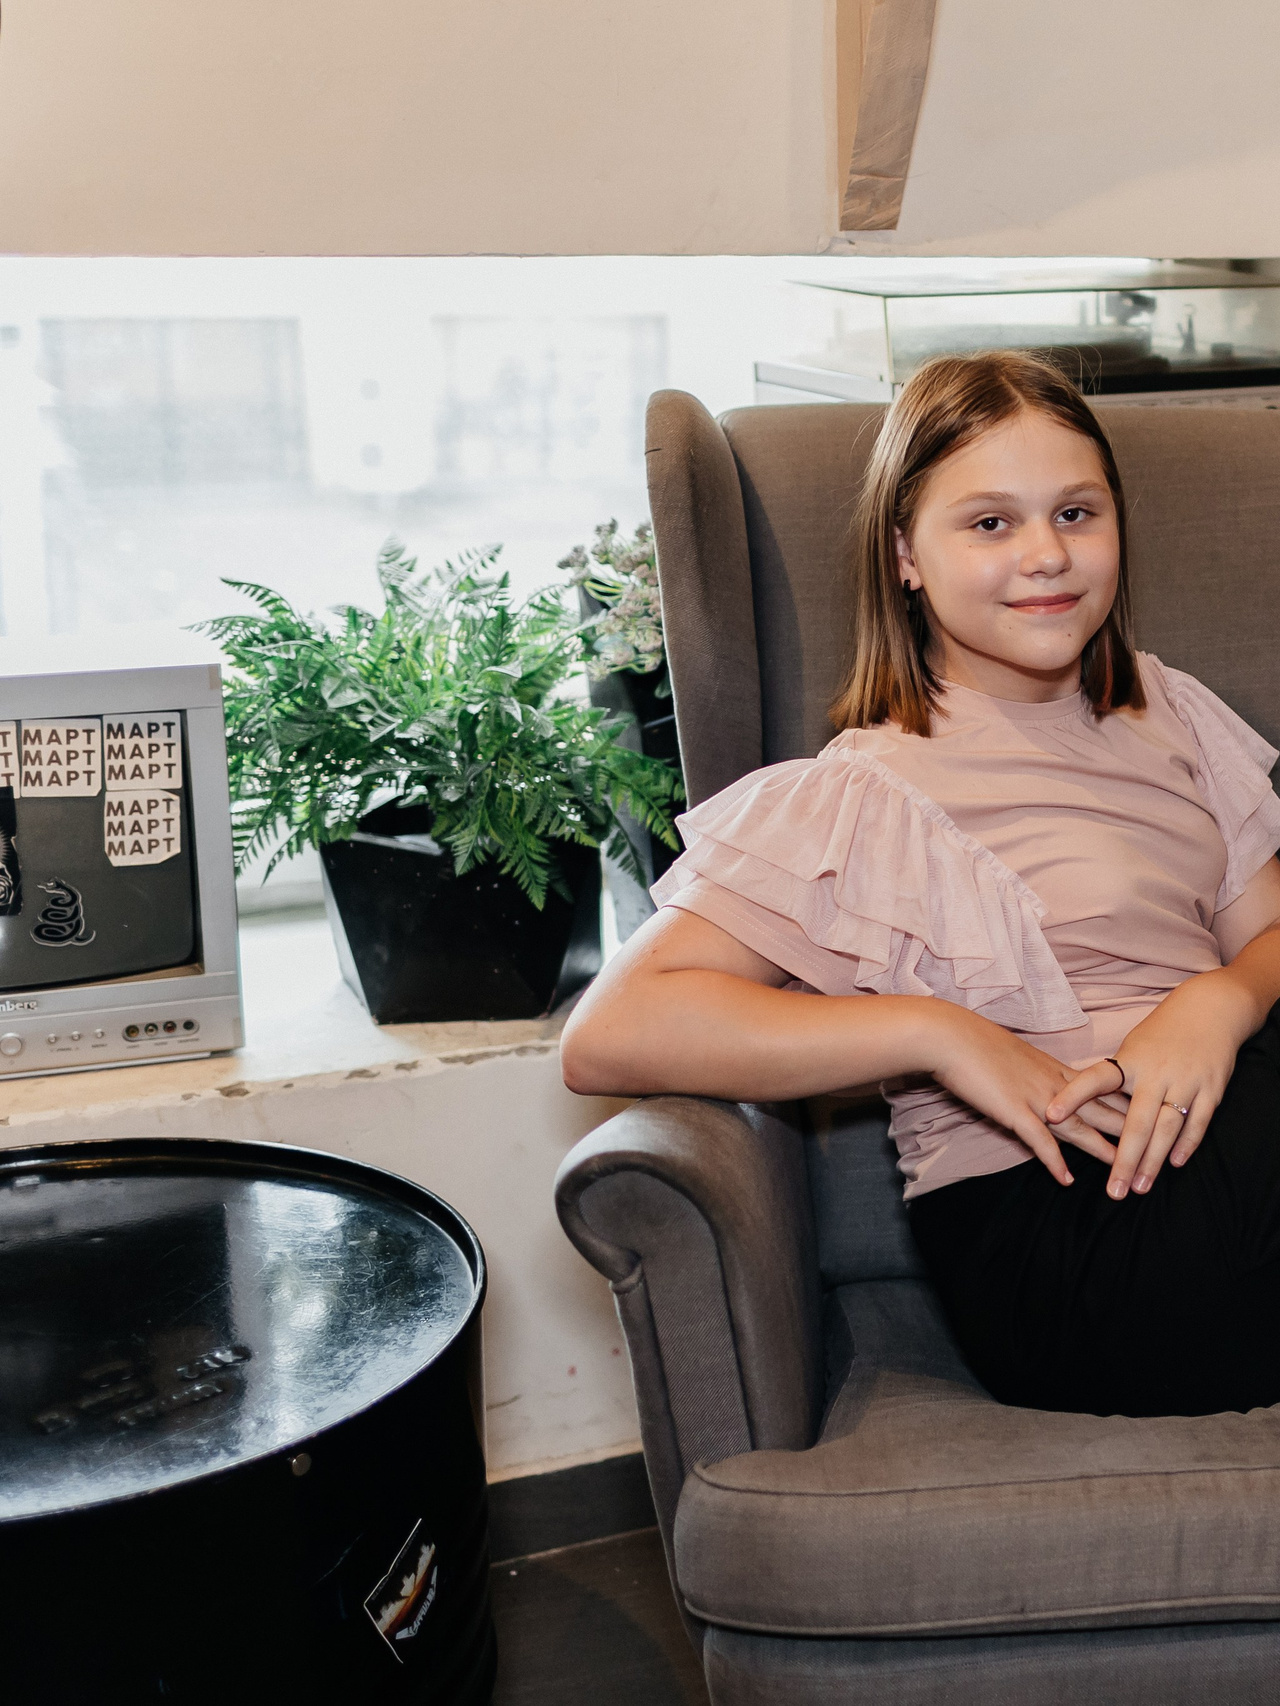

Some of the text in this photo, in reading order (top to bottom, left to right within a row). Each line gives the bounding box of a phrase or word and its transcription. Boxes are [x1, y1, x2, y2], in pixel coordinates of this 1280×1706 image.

[23, 729, 95, 746] МАРТ
[106, 721, 176, 740] МАРТ
[22, 750, 96, 766] МАРТ
[106, 743, 176, 760] МАРТ
[23, 770, 96, 787] МАРТ
[107, 763, 177, 781] МАРТ
[106, 798, 175, 817] МАРТ
[106, 818, 175, 837] МАРТ
[107, 837, 175, 857] МАРТ
